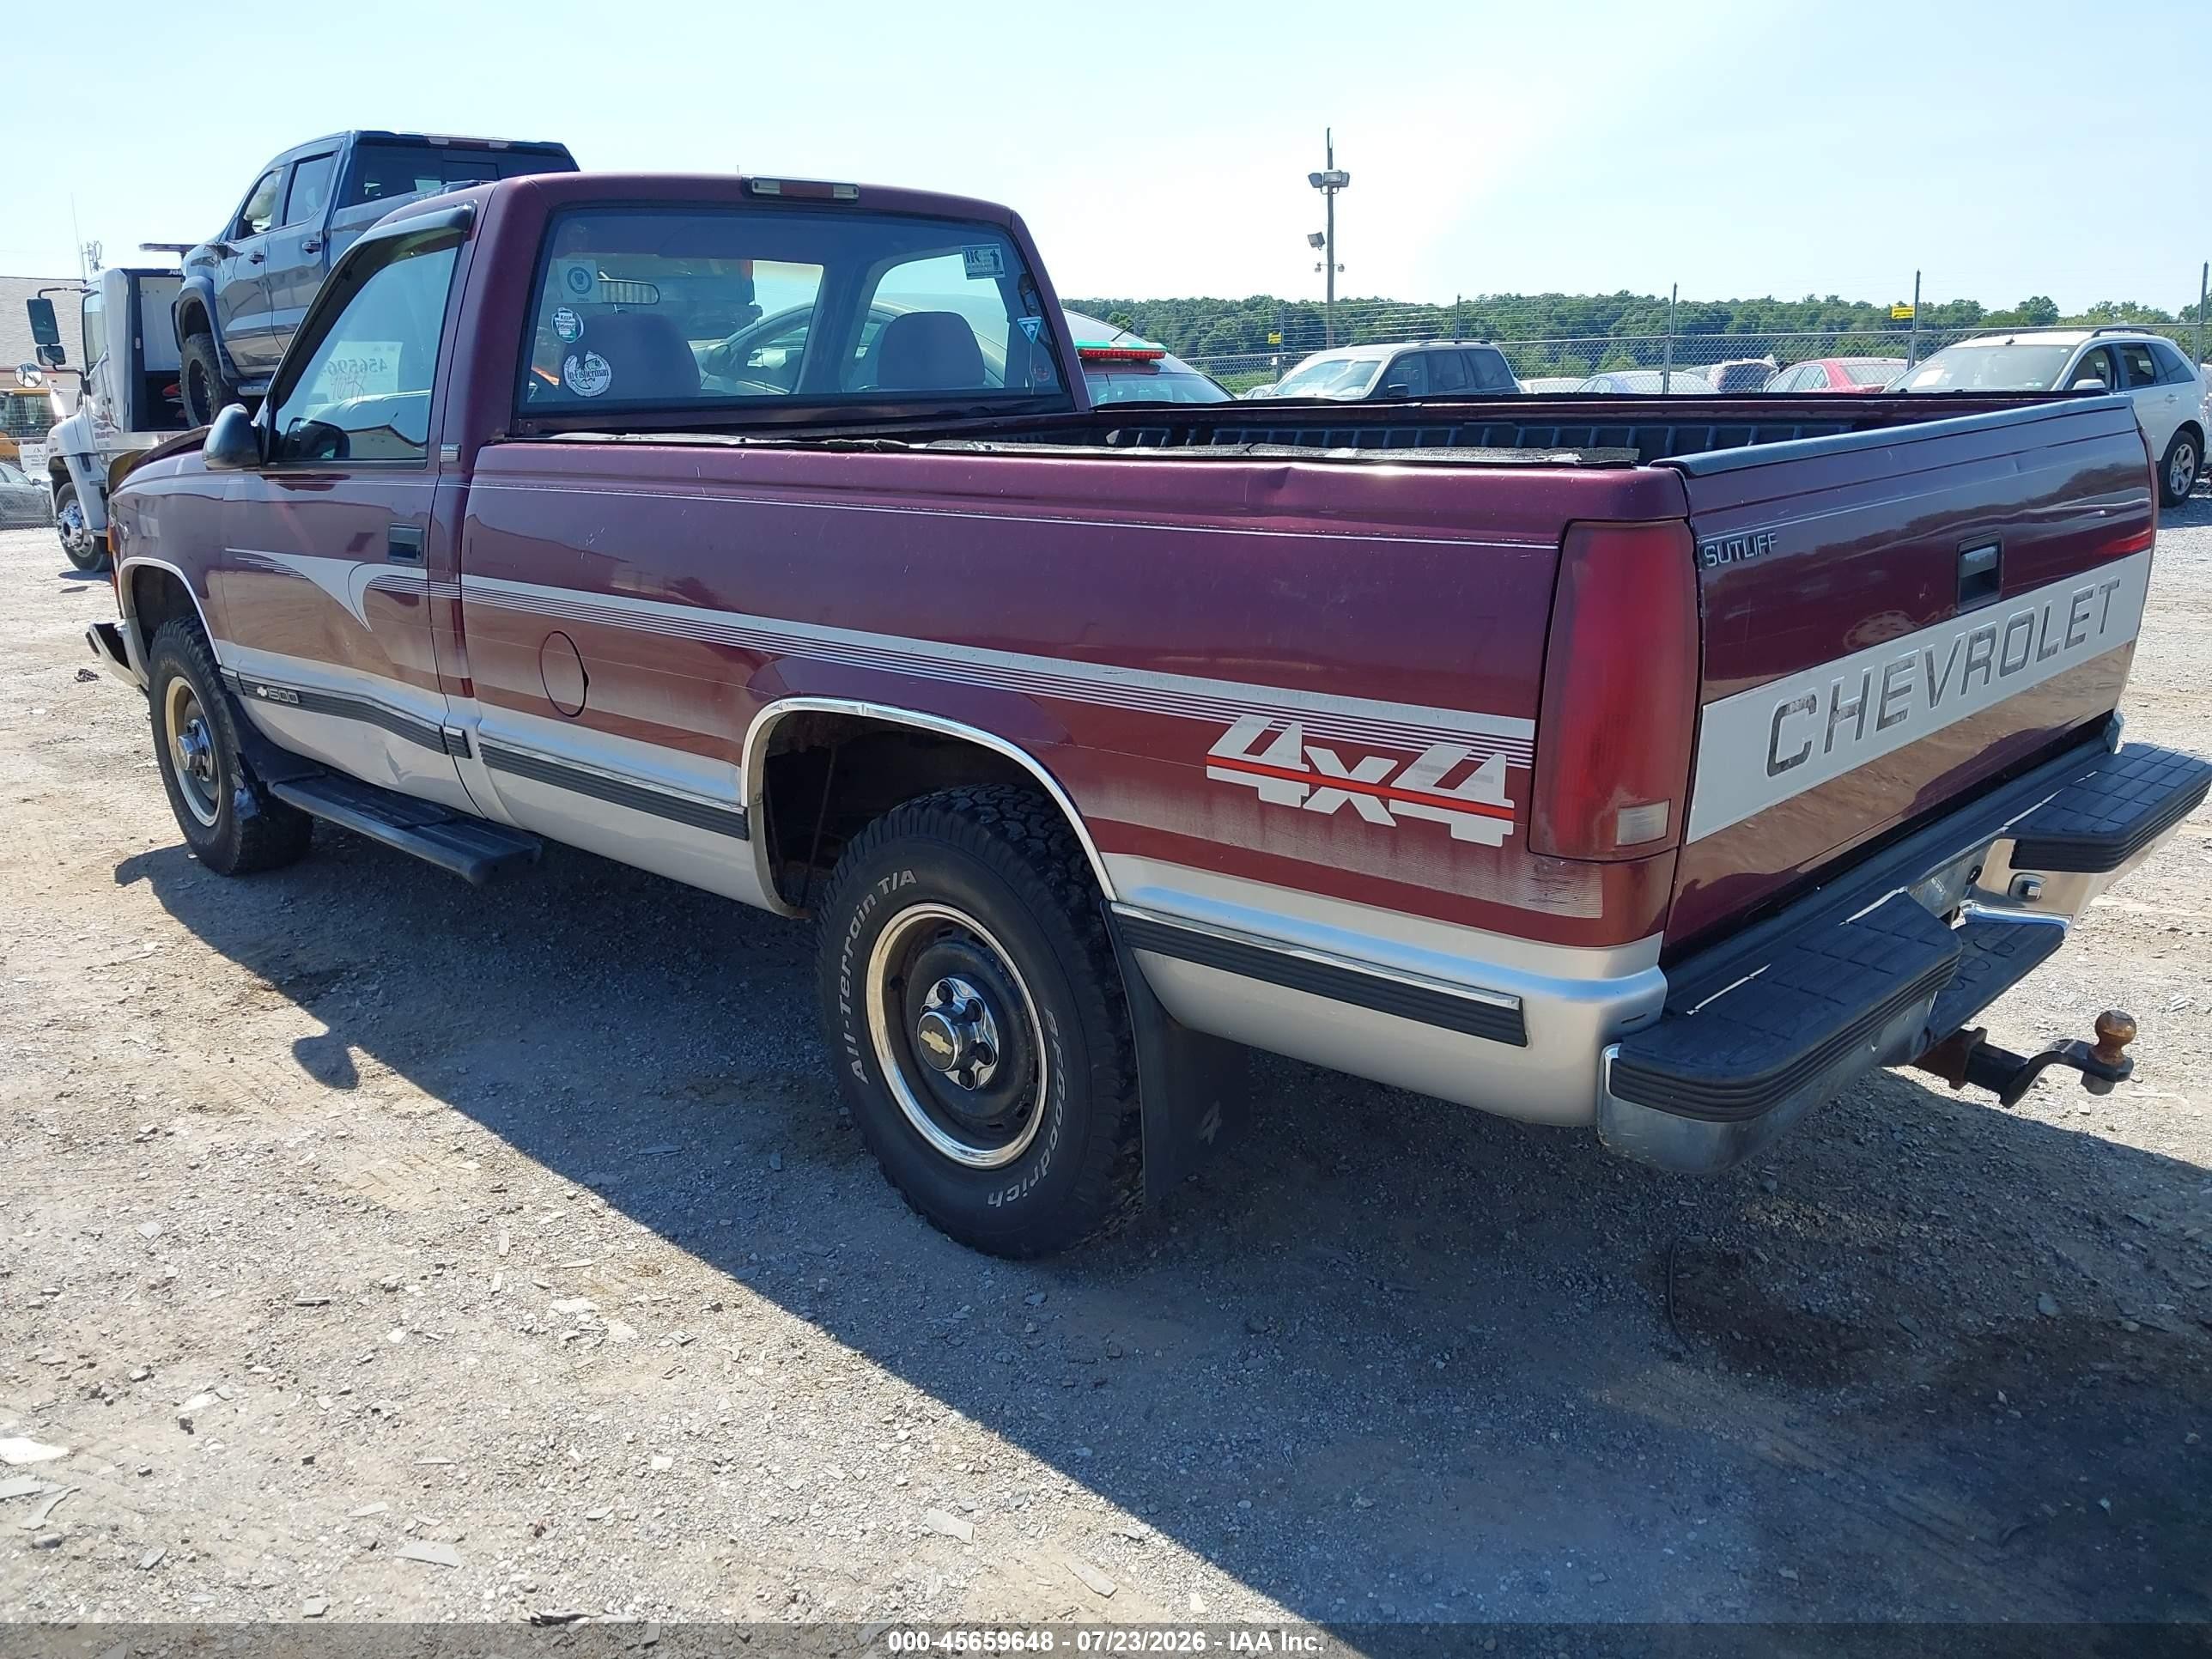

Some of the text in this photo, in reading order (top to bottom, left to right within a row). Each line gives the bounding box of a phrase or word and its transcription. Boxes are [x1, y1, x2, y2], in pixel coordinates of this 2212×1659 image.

[1704, 532, 1778, 567] SUTLIFF
[1766, 574, 2121, 778] CHEVROLET
[840, 869, 917, 1085] All-Terrain T/A
[988, 1007, 1066, 1208] BFGoodrich
